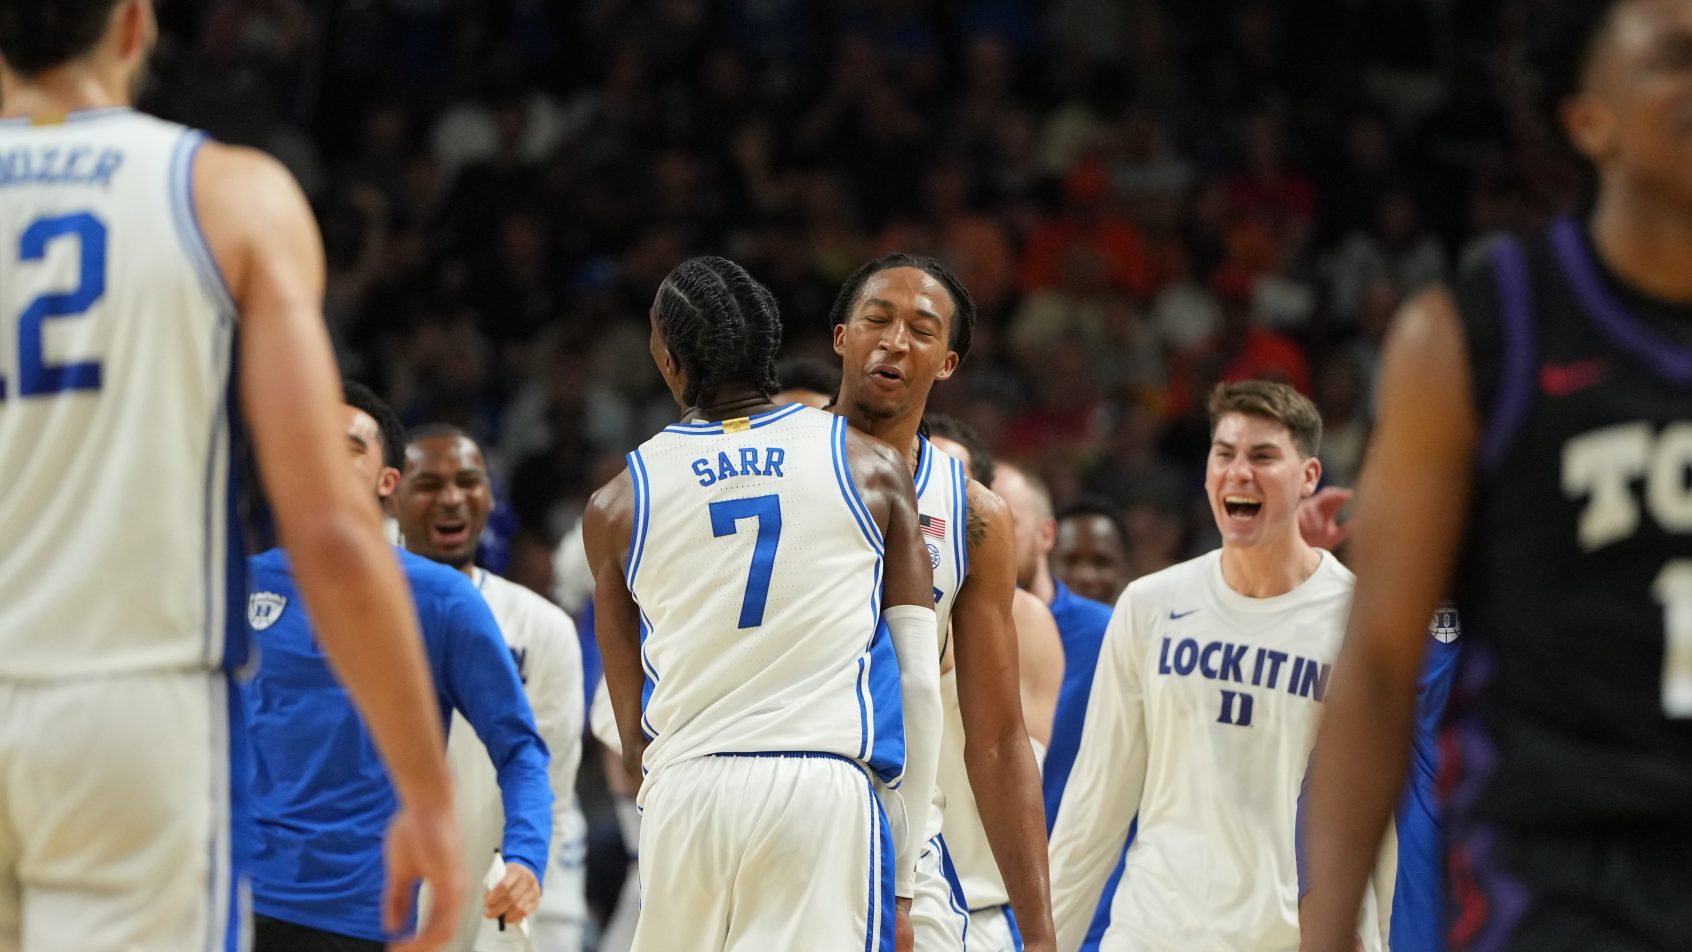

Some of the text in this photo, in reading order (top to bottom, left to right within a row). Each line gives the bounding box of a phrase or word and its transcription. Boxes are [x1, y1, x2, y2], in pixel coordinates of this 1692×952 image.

[0, 144, 126, 190] OZER
[0, 209, 106, 398] 2
[691, 447, 785, 487] SARR
[708, 493, 783, 630] 7
[1158, 637, 1331, 703] LOCK IT IN
[1216, 689, 1254, 727] D
